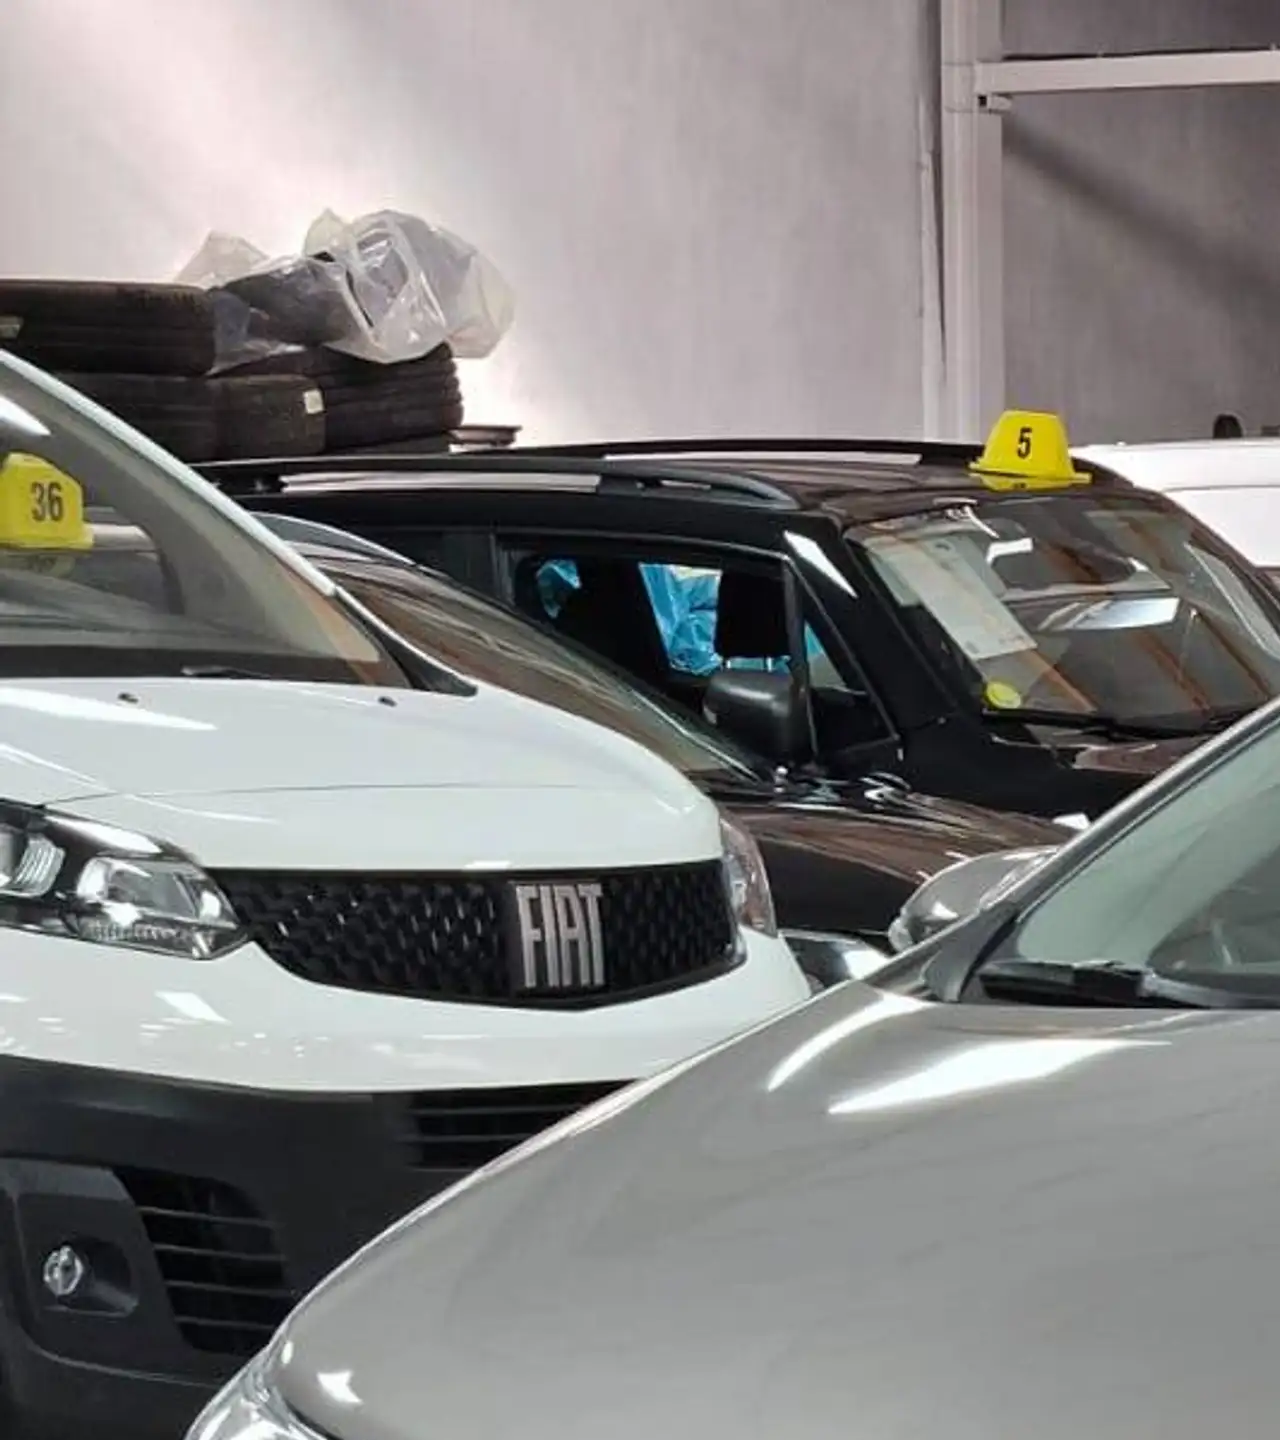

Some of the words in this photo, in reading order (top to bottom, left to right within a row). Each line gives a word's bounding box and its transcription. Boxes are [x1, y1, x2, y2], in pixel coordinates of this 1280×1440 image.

[1017, 426, 1032, 459] 5
[31, 481, 64, 522] 36
[515, 884, 605, 988] FIAT
